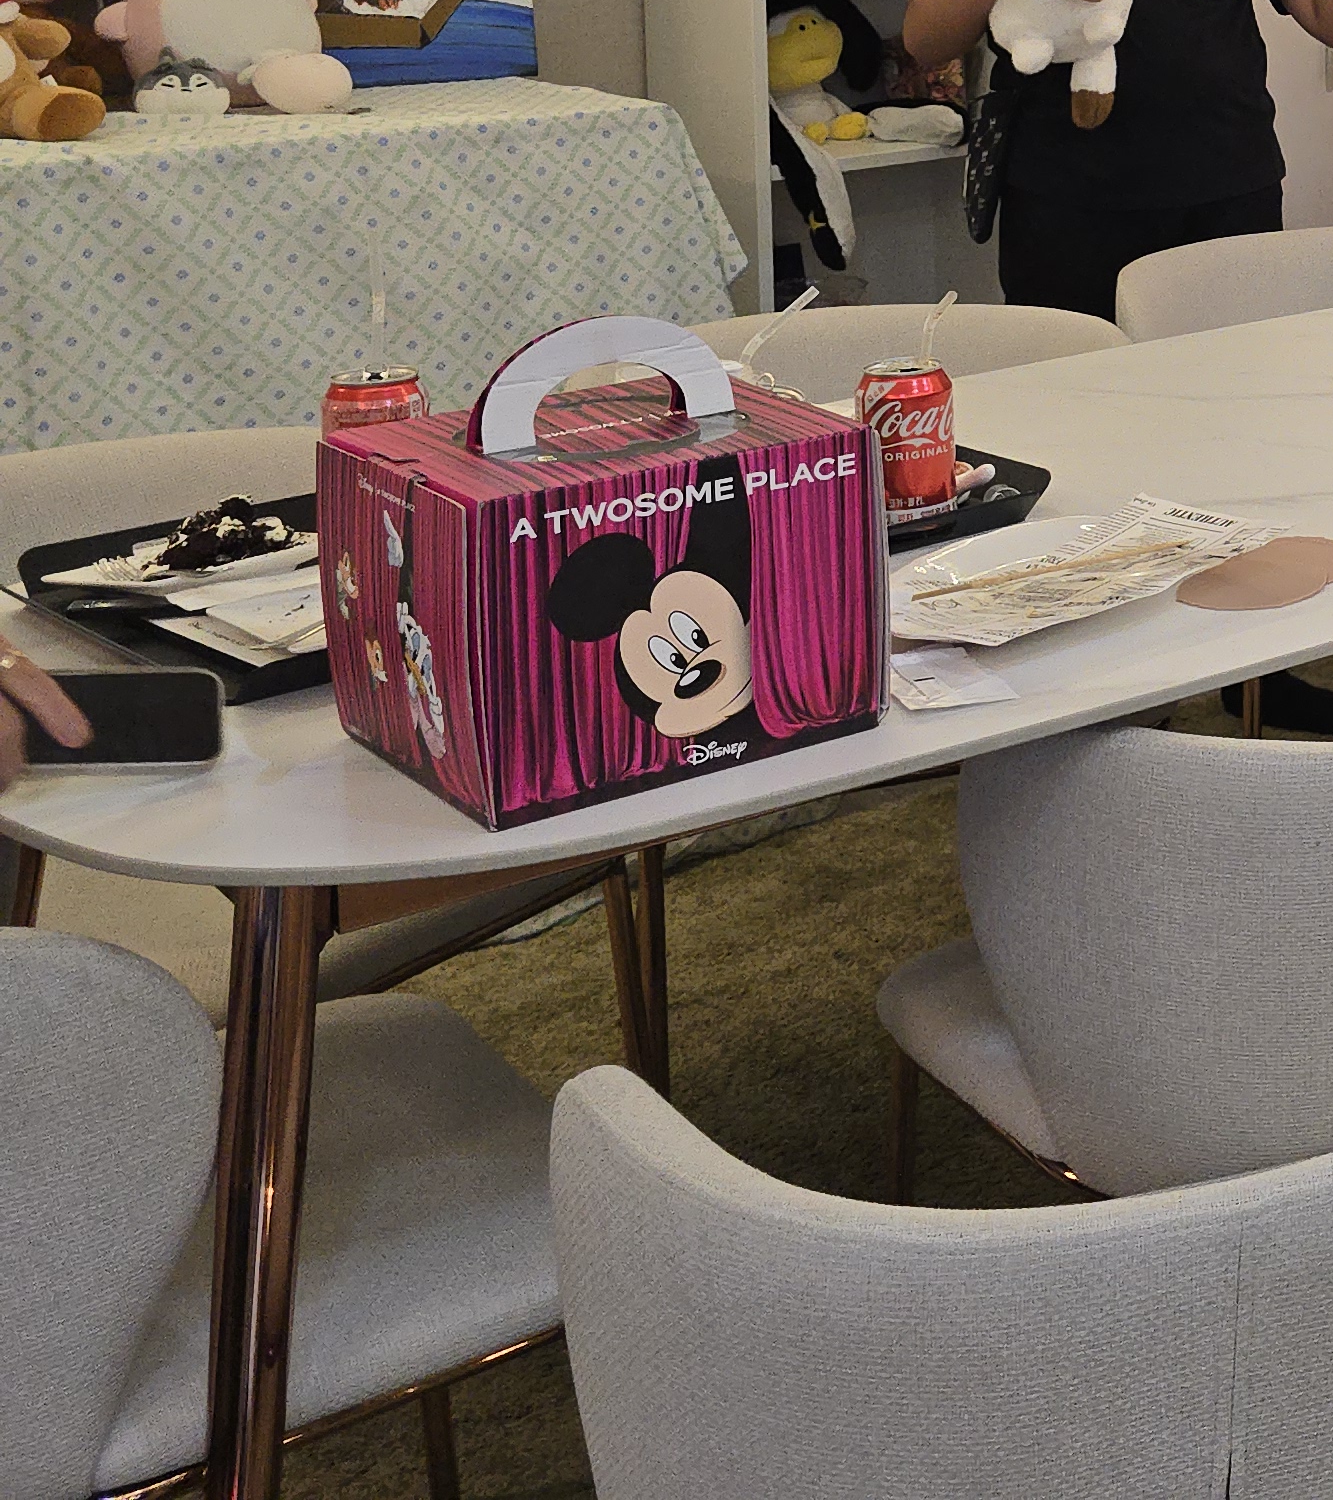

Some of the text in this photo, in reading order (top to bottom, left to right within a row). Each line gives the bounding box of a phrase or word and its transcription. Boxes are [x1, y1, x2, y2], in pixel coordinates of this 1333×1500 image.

[884, 445, 949, 462] ORIGINAL
[509, 453, 857, 543] A TWOSOME PLACE
[1163, 507, 1238, 527] AUTHENTIC
[683, 740, 748, 766] Disney
